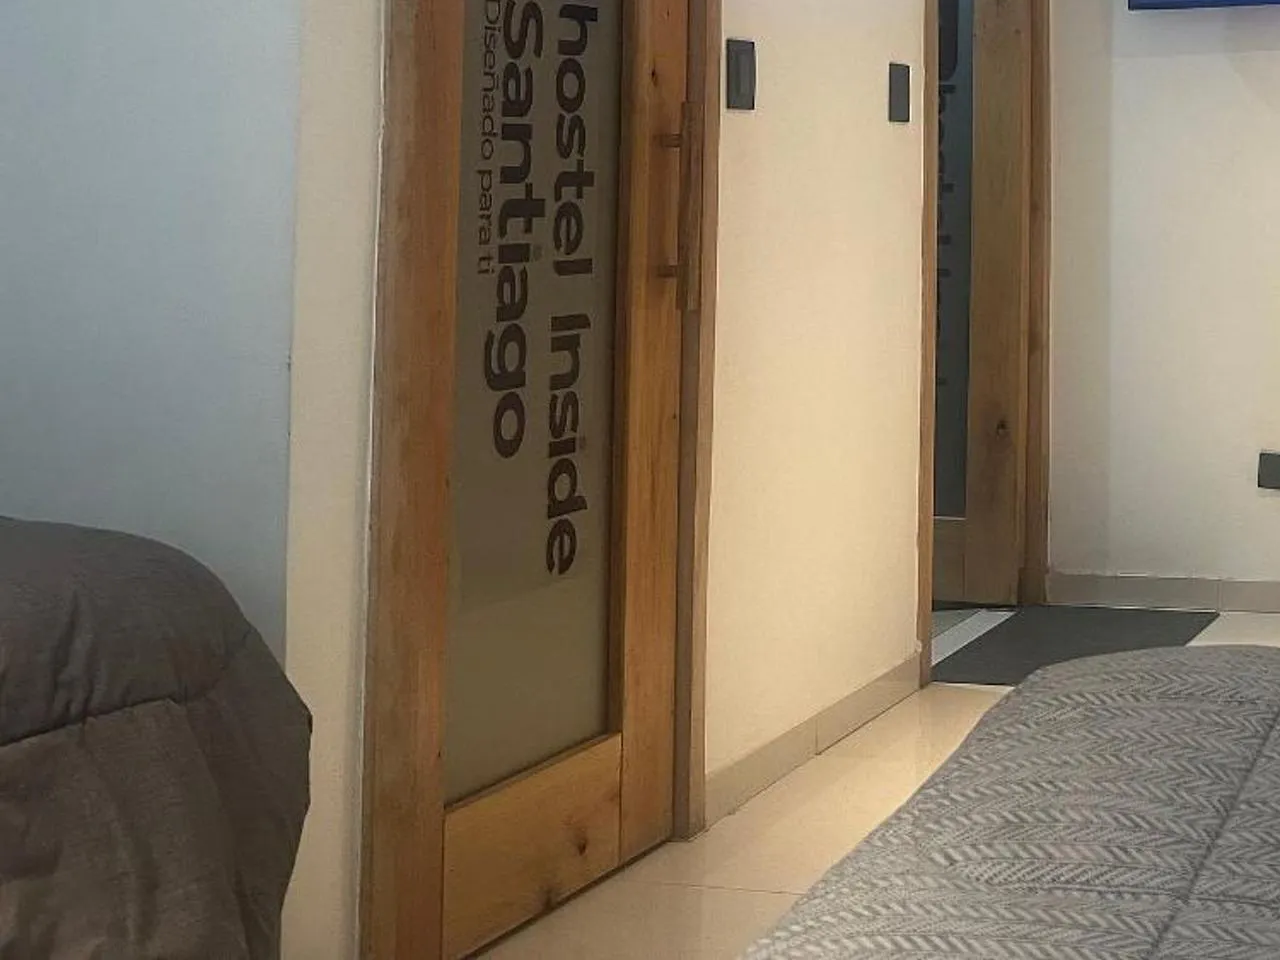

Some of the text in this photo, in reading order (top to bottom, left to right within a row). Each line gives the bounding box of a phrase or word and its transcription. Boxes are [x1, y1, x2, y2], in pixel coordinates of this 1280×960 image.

[476, 169, 493, 246] para
[477, 252, 495, 275] ti
[545, 3, 599, 575] hostel Inside
